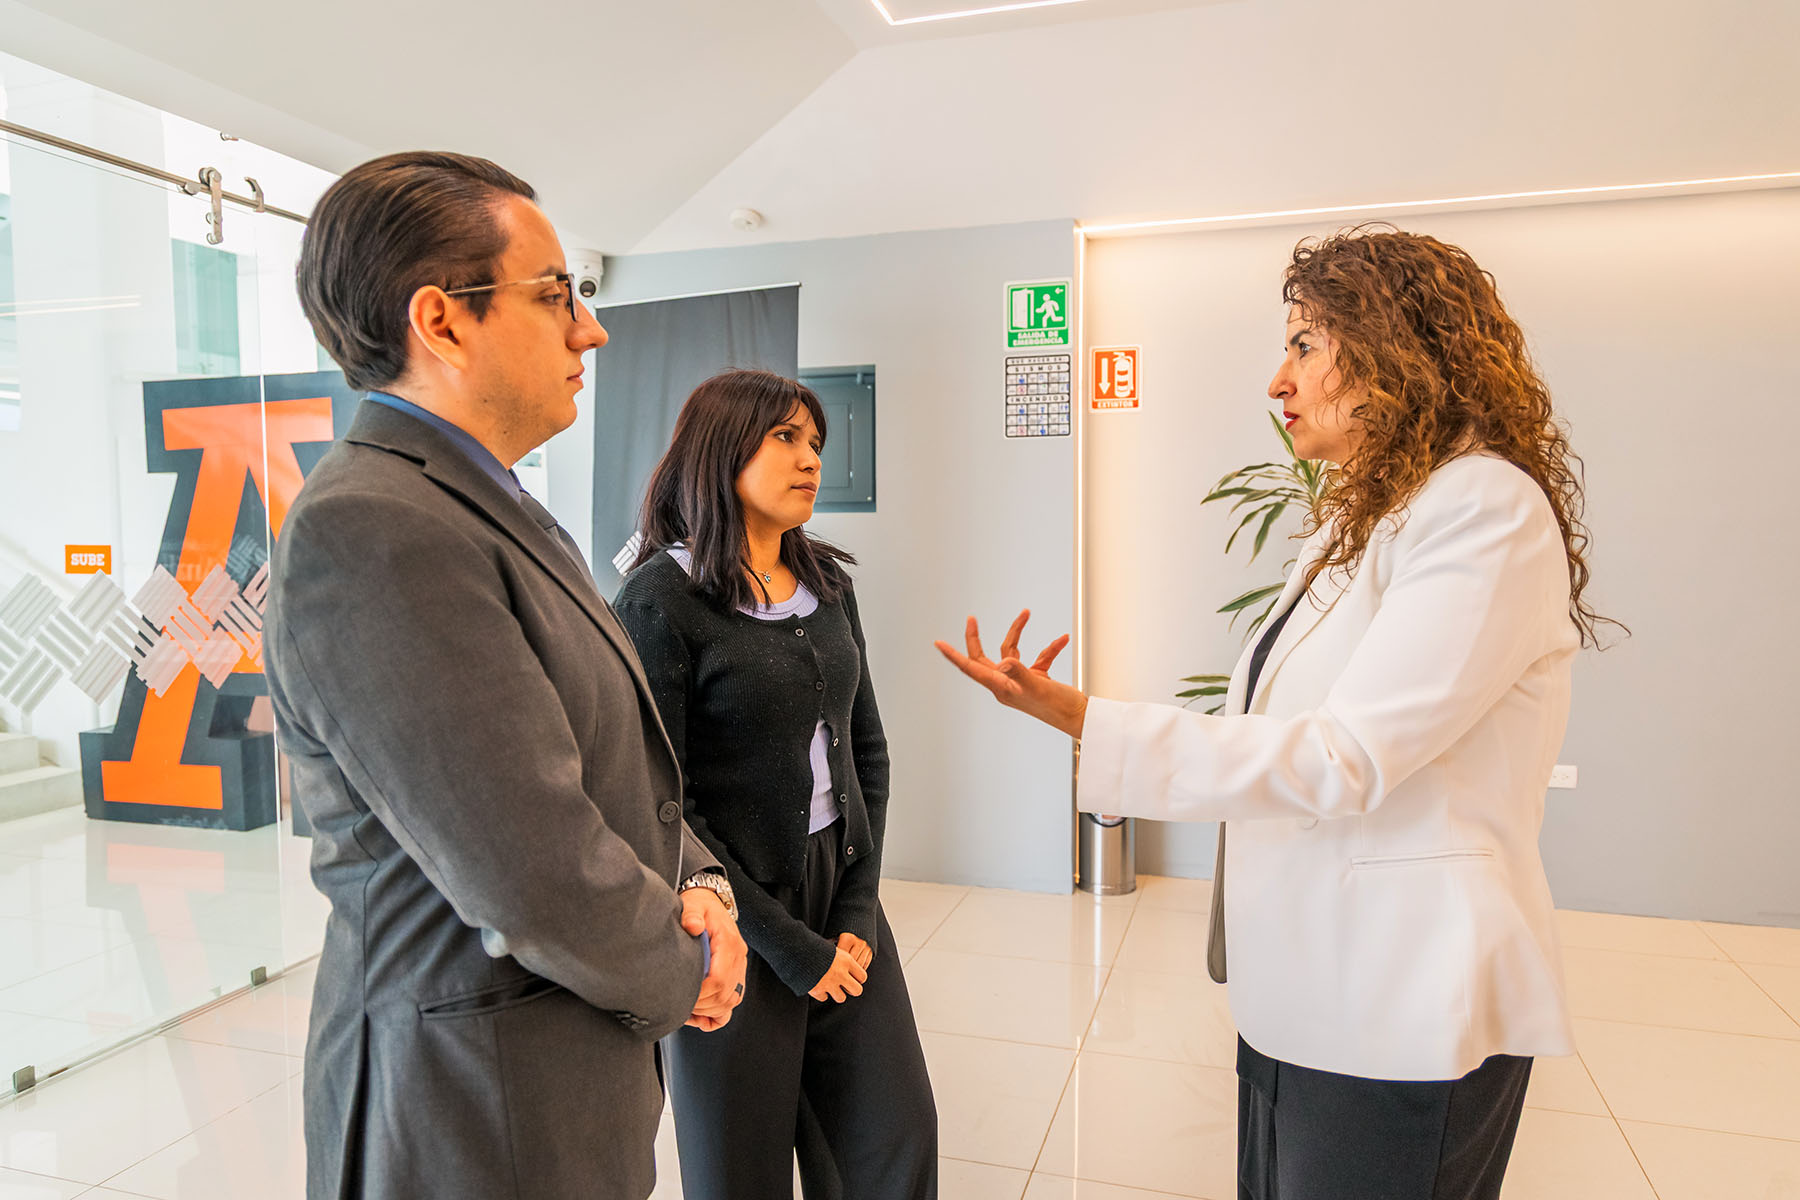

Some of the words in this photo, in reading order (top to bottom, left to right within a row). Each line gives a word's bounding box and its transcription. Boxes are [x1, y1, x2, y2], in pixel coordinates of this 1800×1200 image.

[1017, 331, 1046, 339] SALIDA
[1048, 330, 1058, 338] DE
[1013, 337, 1064, 346] EMERGENCIA
[1097, 400, 1133, 409] EXTINTOR
[71, 553, 105, 566] SUBE
